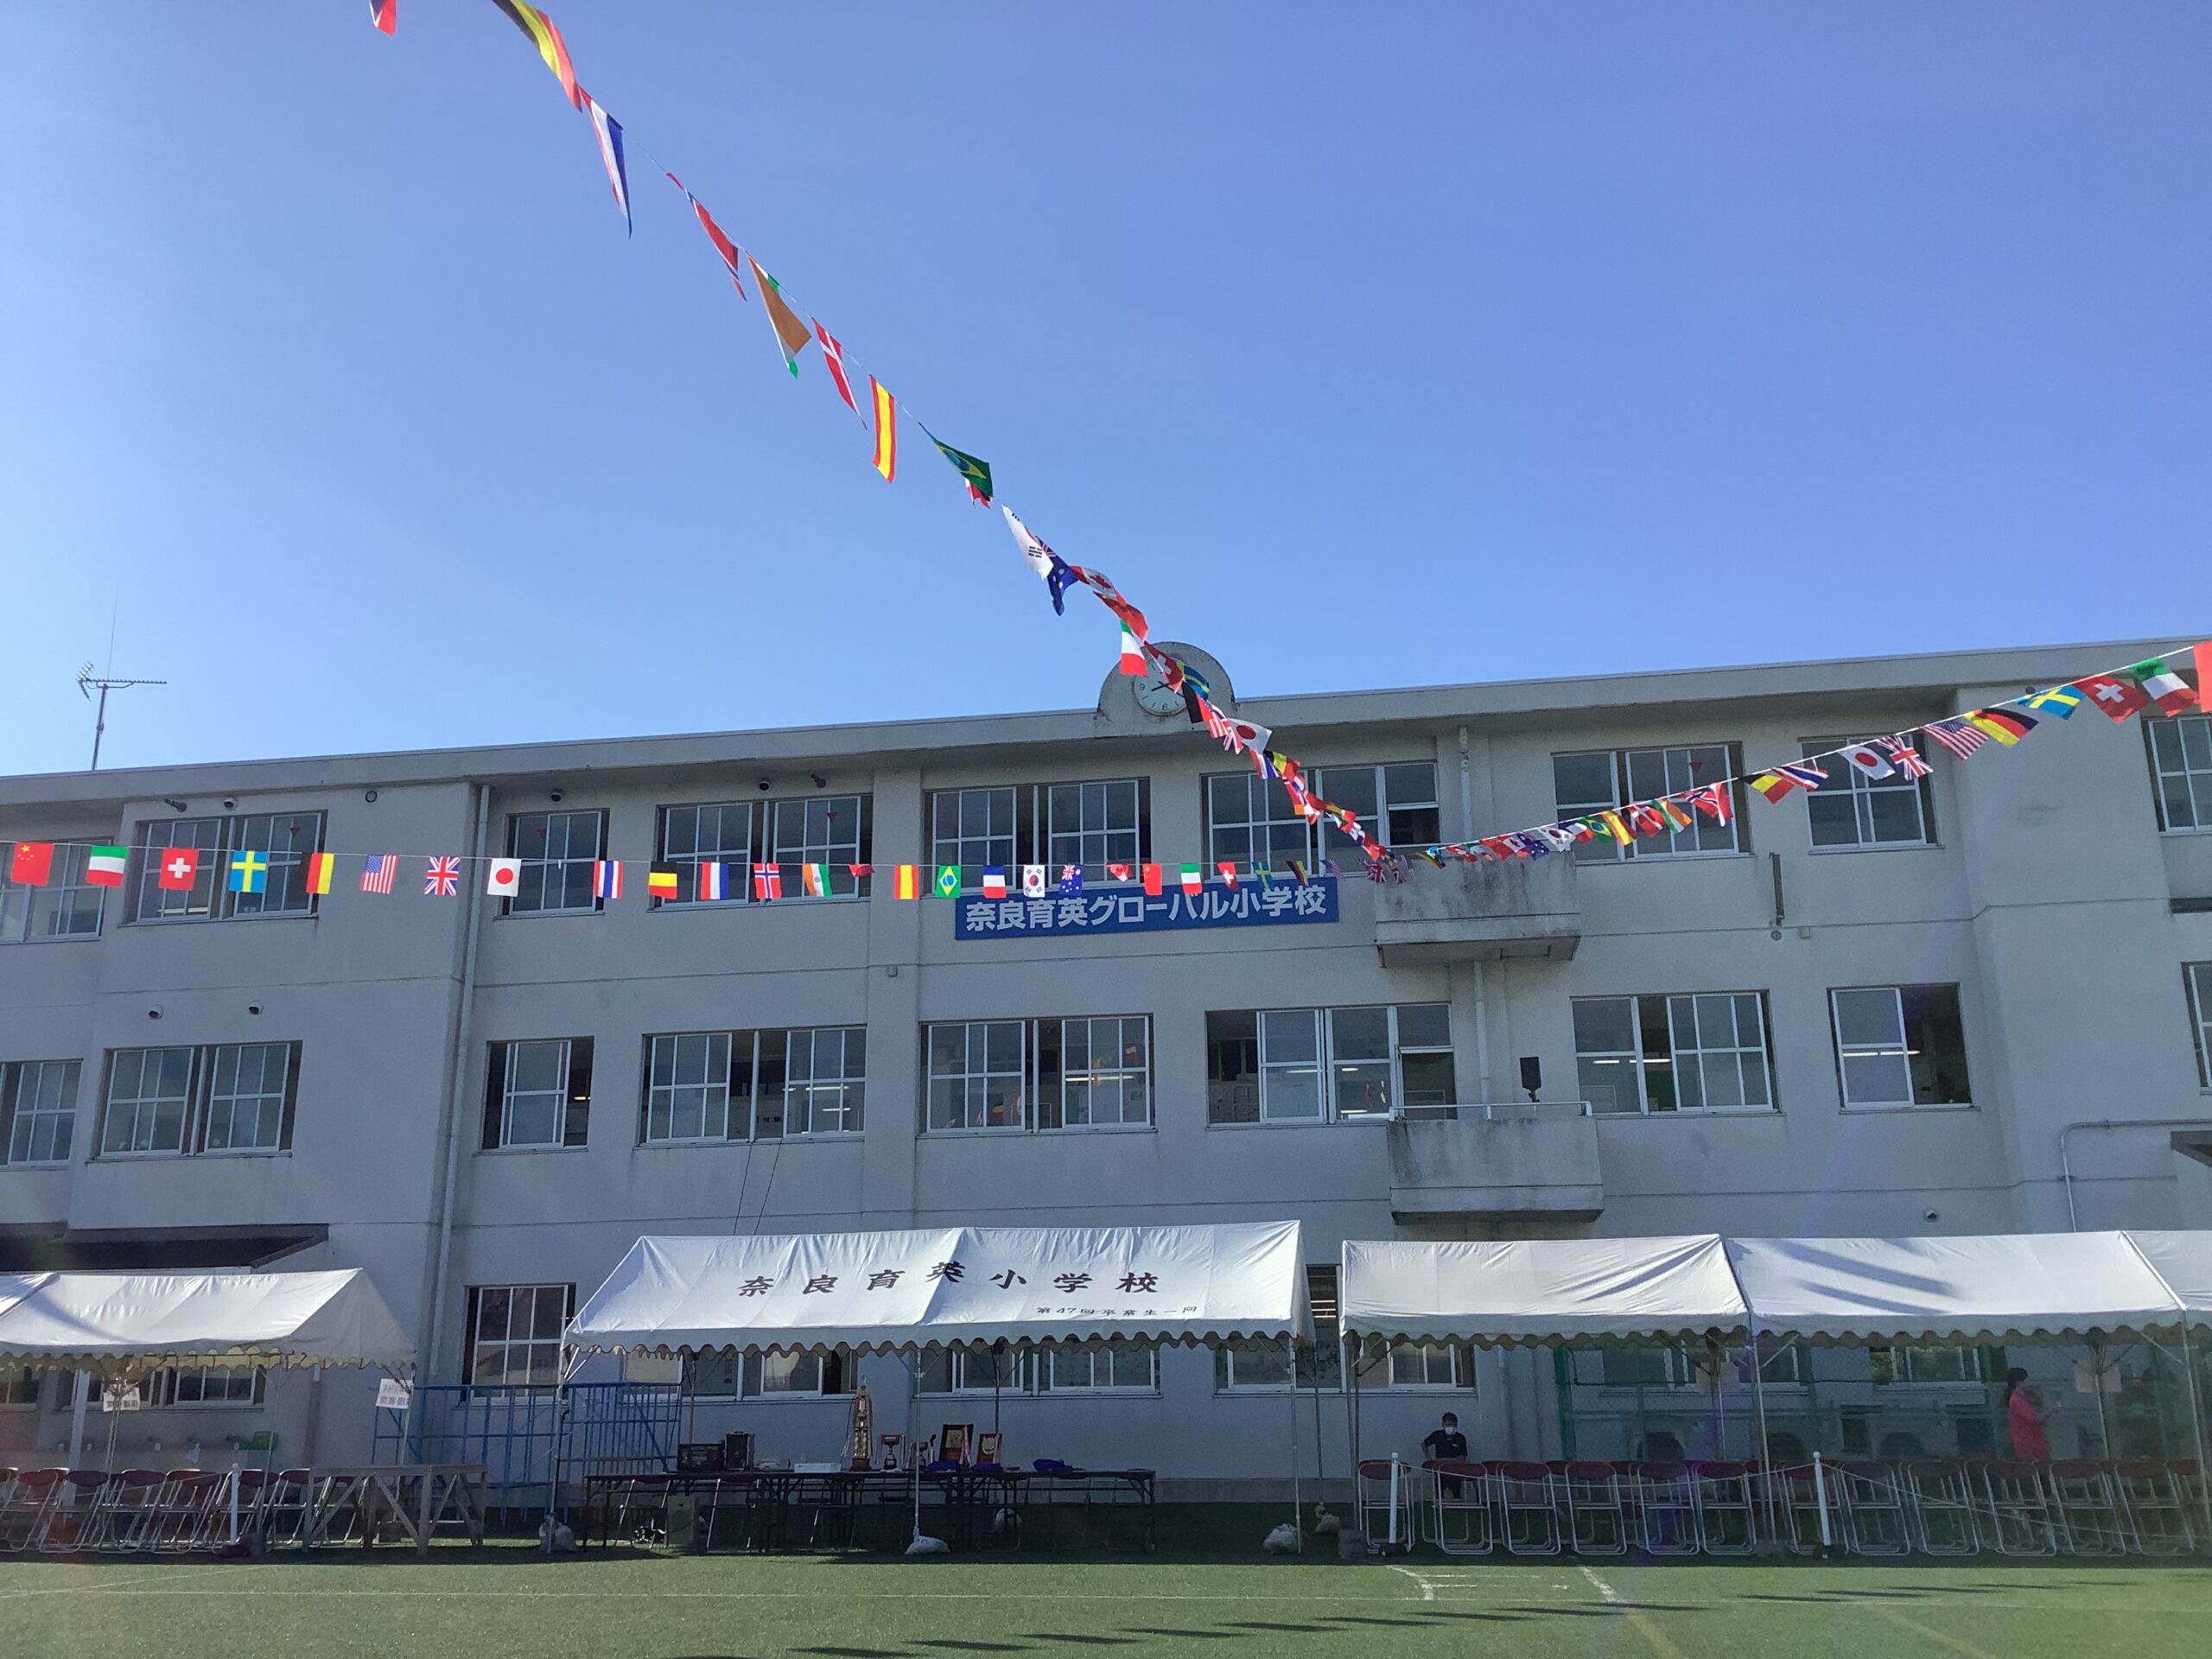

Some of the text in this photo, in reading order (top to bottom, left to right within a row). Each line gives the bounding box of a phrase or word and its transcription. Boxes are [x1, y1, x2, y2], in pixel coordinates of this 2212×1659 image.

[965, 884, 1327, 931] 奈良育英グローバル小学校
[737, 1261, 1159, 1296] 奈良育英小学校
